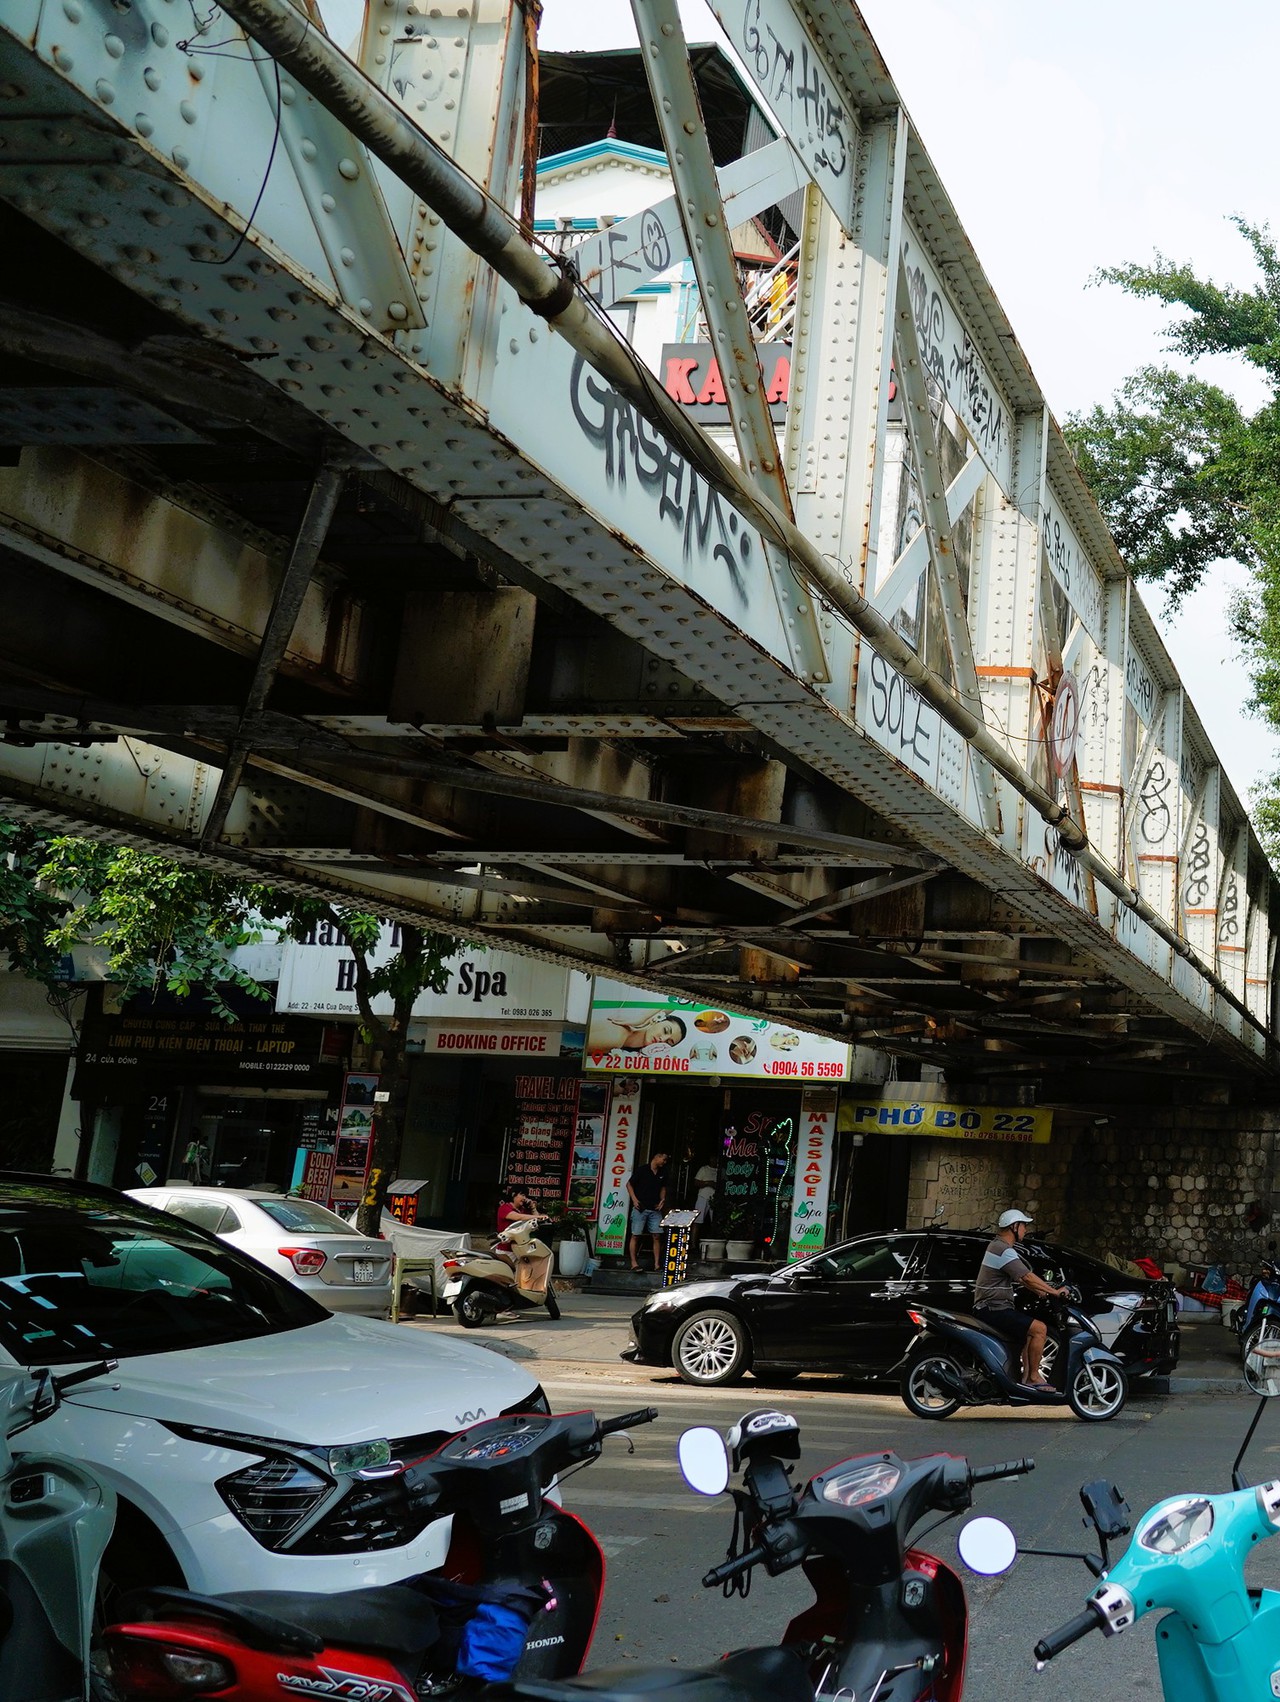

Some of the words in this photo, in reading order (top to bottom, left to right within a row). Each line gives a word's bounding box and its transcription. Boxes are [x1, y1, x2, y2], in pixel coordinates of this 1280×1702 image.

[458, 962, 507, 1002] Spa
[287, 1002, 299, 1010] Add:
[301, 1002, 309, 1010] 22
[326, 1003, 337, 1011] Cua
[338, 1004, 353, 1012] Dong
[501, 1008, 511, 1016] Tel:
[512, 1008, 527, 1016] 0983
[528, 1008, 540, 1016] 026
[541, 1008, 553, 1017] 365
[108, 1034, 132, 1047] LINH
[134, 1036, 155, 1051] PHỤ
[158, 1036, 182, 1052] KIỆN
[186, 1037, 211, 1053] ĐIỆN
[214, 1038, 244, 1054] THOẠI
[256, 1040, 296, 1054] LAPTOP
[438, 1033, 496, 1051] BOOKING
[501, 1035, 547, 1052] OFFICE
[85, 1053, 97, 1064] 24
[239, 1061, 265, 1070] MOBILE:
[605, 1056, 621, 1069] 22
[624, 1055, 652, 1070] CỬA
[653, 1055, 690, 1072] ĐÔNG
[772, 1060, 799, 1076] 0904
[801, 1061, 815, 1076] 56
[817, 1062, 844, 1078] 5599
[515, 1076, 556, 1100] TRAVEL
[148, 1096, 168, 1112] 24
[855, 1103, 926, 1125] PHỞ
[935, 1107, 982, 1130] BÒ
[993, 1113, 1036, 1133] 22
[612, 1104, 633, 1188] MASSAGE
[803, 1112, 828, 1197] MASSAGE
[309, 1151, 332, 1170] COLD
[539, 1150, 561, 1161] South
[307, 1167, 330, 1186] BEER
[524, 1163, 542, 1173] Laos
[525, 1174, 561, 1186] Extension
[798, 1200, 824, 1219] Spa
[603, 1214, 624, 1227] Body
[794, 1223, 823, 1238] Body
[667, 1233, 679, 1285] FOOT
[526, 1635, 565, 1650] HONDA
